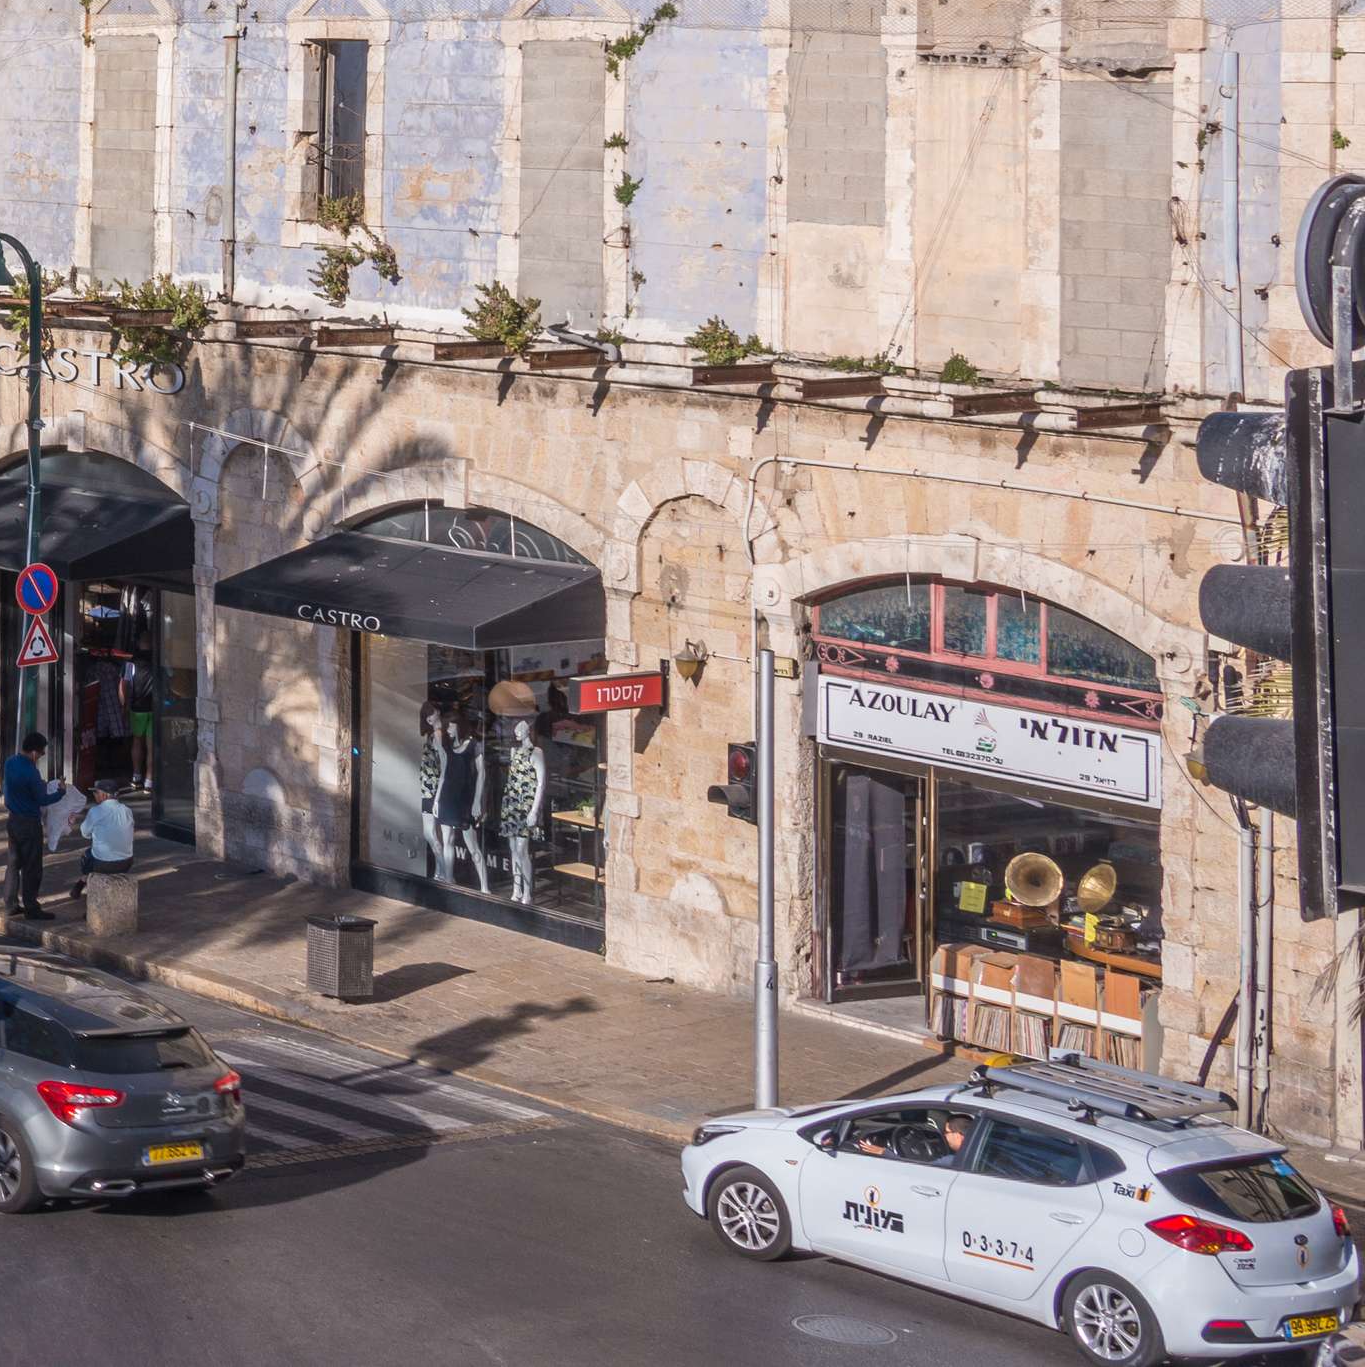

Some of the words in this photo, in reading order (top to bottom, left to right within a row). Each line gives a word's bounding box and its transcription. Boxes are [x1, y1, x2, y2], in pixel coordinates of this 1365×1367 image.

[297, 604, 381, 632] CASTRO
[596, 684, 644, 703] קסטרו
[848, 688, 957, 724] AZOULAY
[867, 733, 893, 744] RAZIEL
[1020, 717, 1120, 753] אזולאי
[1112, 1182, 1136, 1199] Taxi
